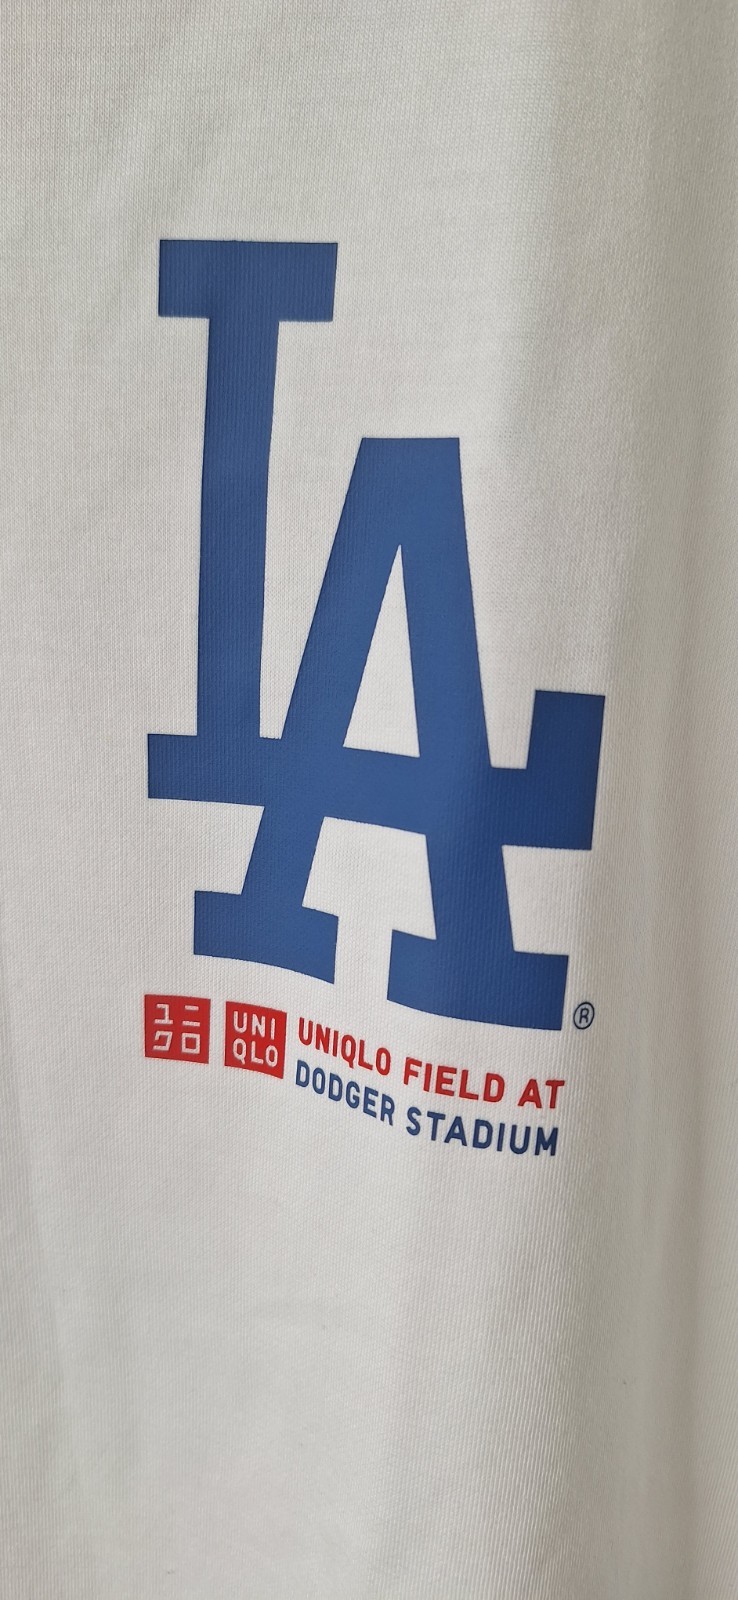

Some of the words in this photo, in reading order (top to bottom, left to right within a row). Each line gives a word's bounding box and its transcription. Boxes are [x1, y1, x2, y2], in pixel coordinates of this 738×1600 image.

[148, 240, 605, 1031] LA
[232, 1038, 279, 1068] QLO
[233, 1010, 276, 1041] UNI
[298, 1017, 391, 1076] UNIQLO
[403, 1057, 505, 1103] FIELD
[517, 1078, 565, 1109] AT
[295, 1060, 395, 1126] DODGER
[407, 1107, 559, 1156] STADIUM
